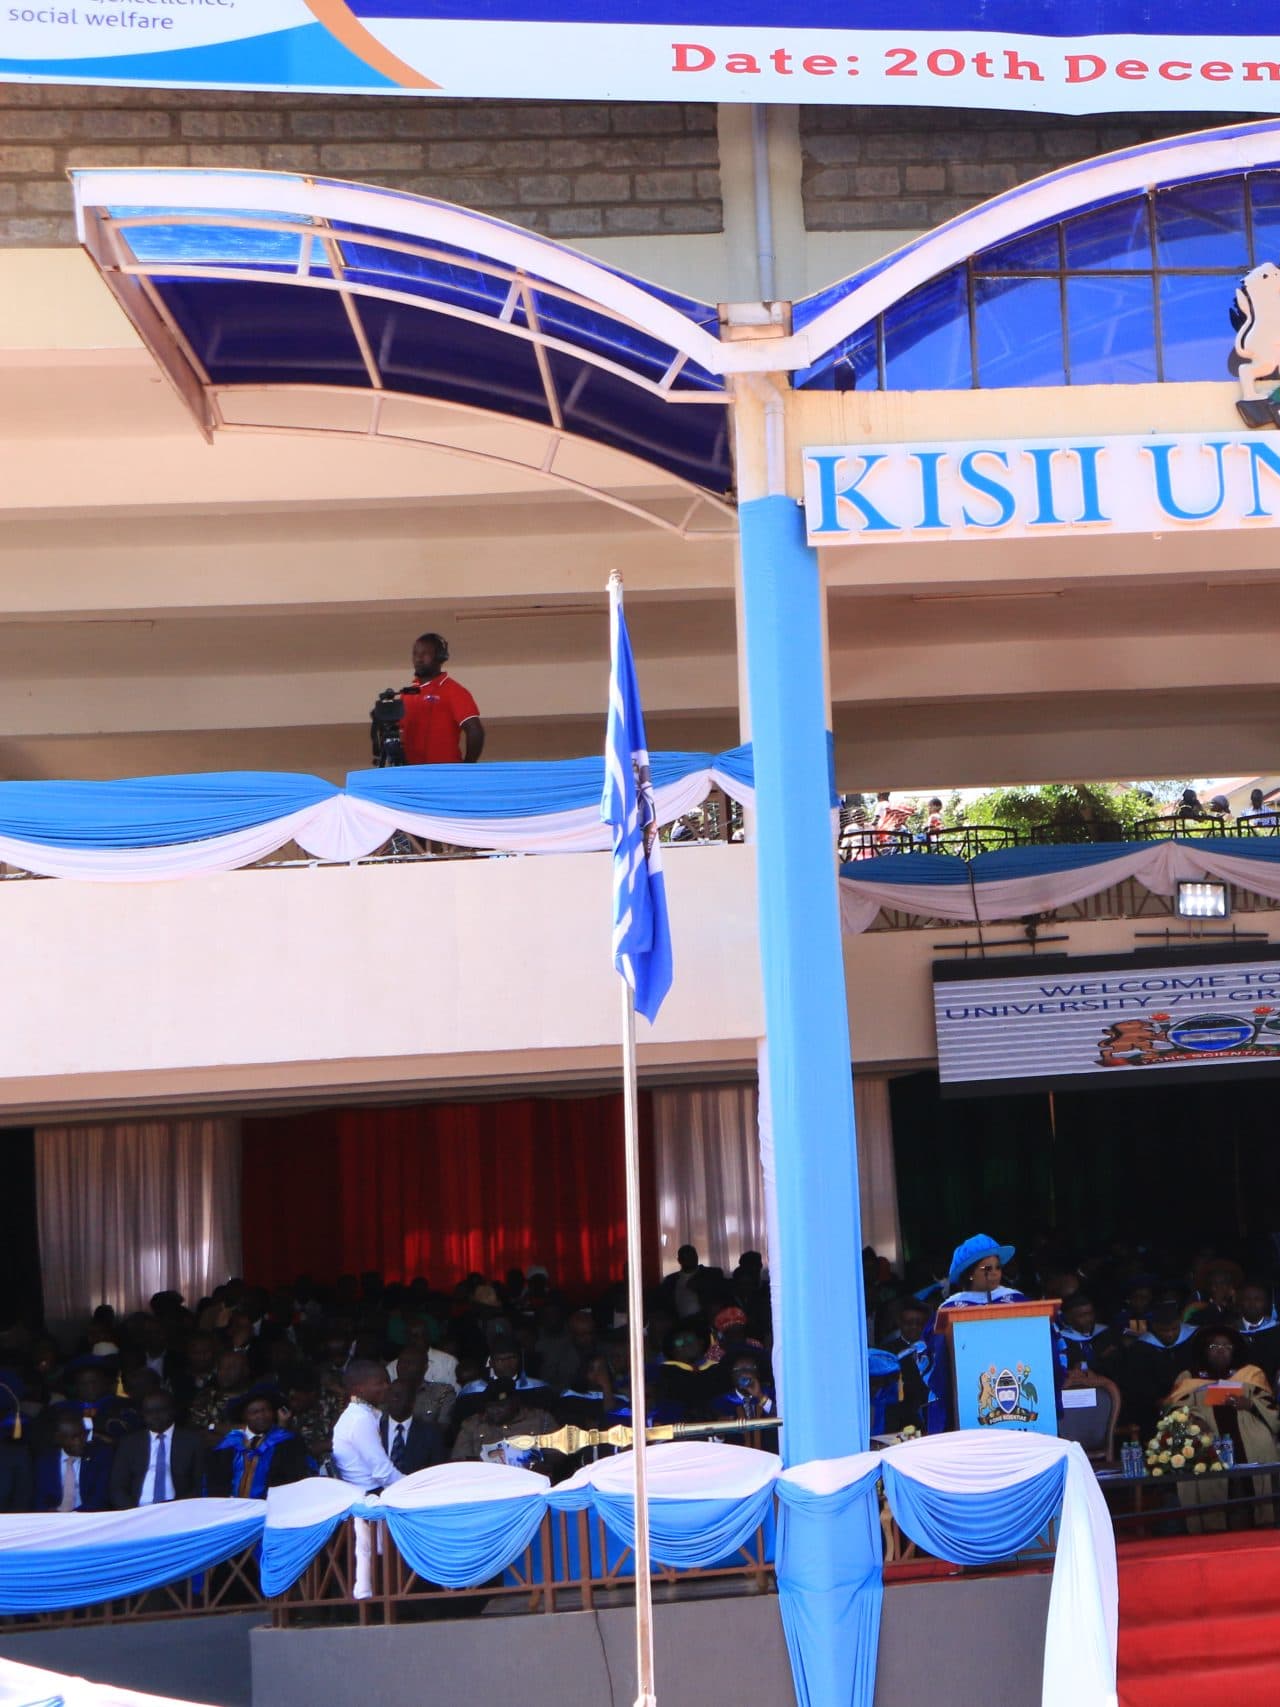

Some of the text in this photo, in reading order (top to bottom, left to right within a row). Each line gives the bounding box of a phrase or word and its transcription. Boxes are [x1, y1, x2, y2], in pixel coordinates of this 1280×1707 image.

[9, 8, 174, 30] social welfare
[671, 43, 860, 76] Date:
[884, 47, 1045, 82] 20th
[806, 446, 1113, 536] KISII
[1040, 976, 1225, 997] WELCOME
[945, 995, 1152, 1020] UNIVERSITY
